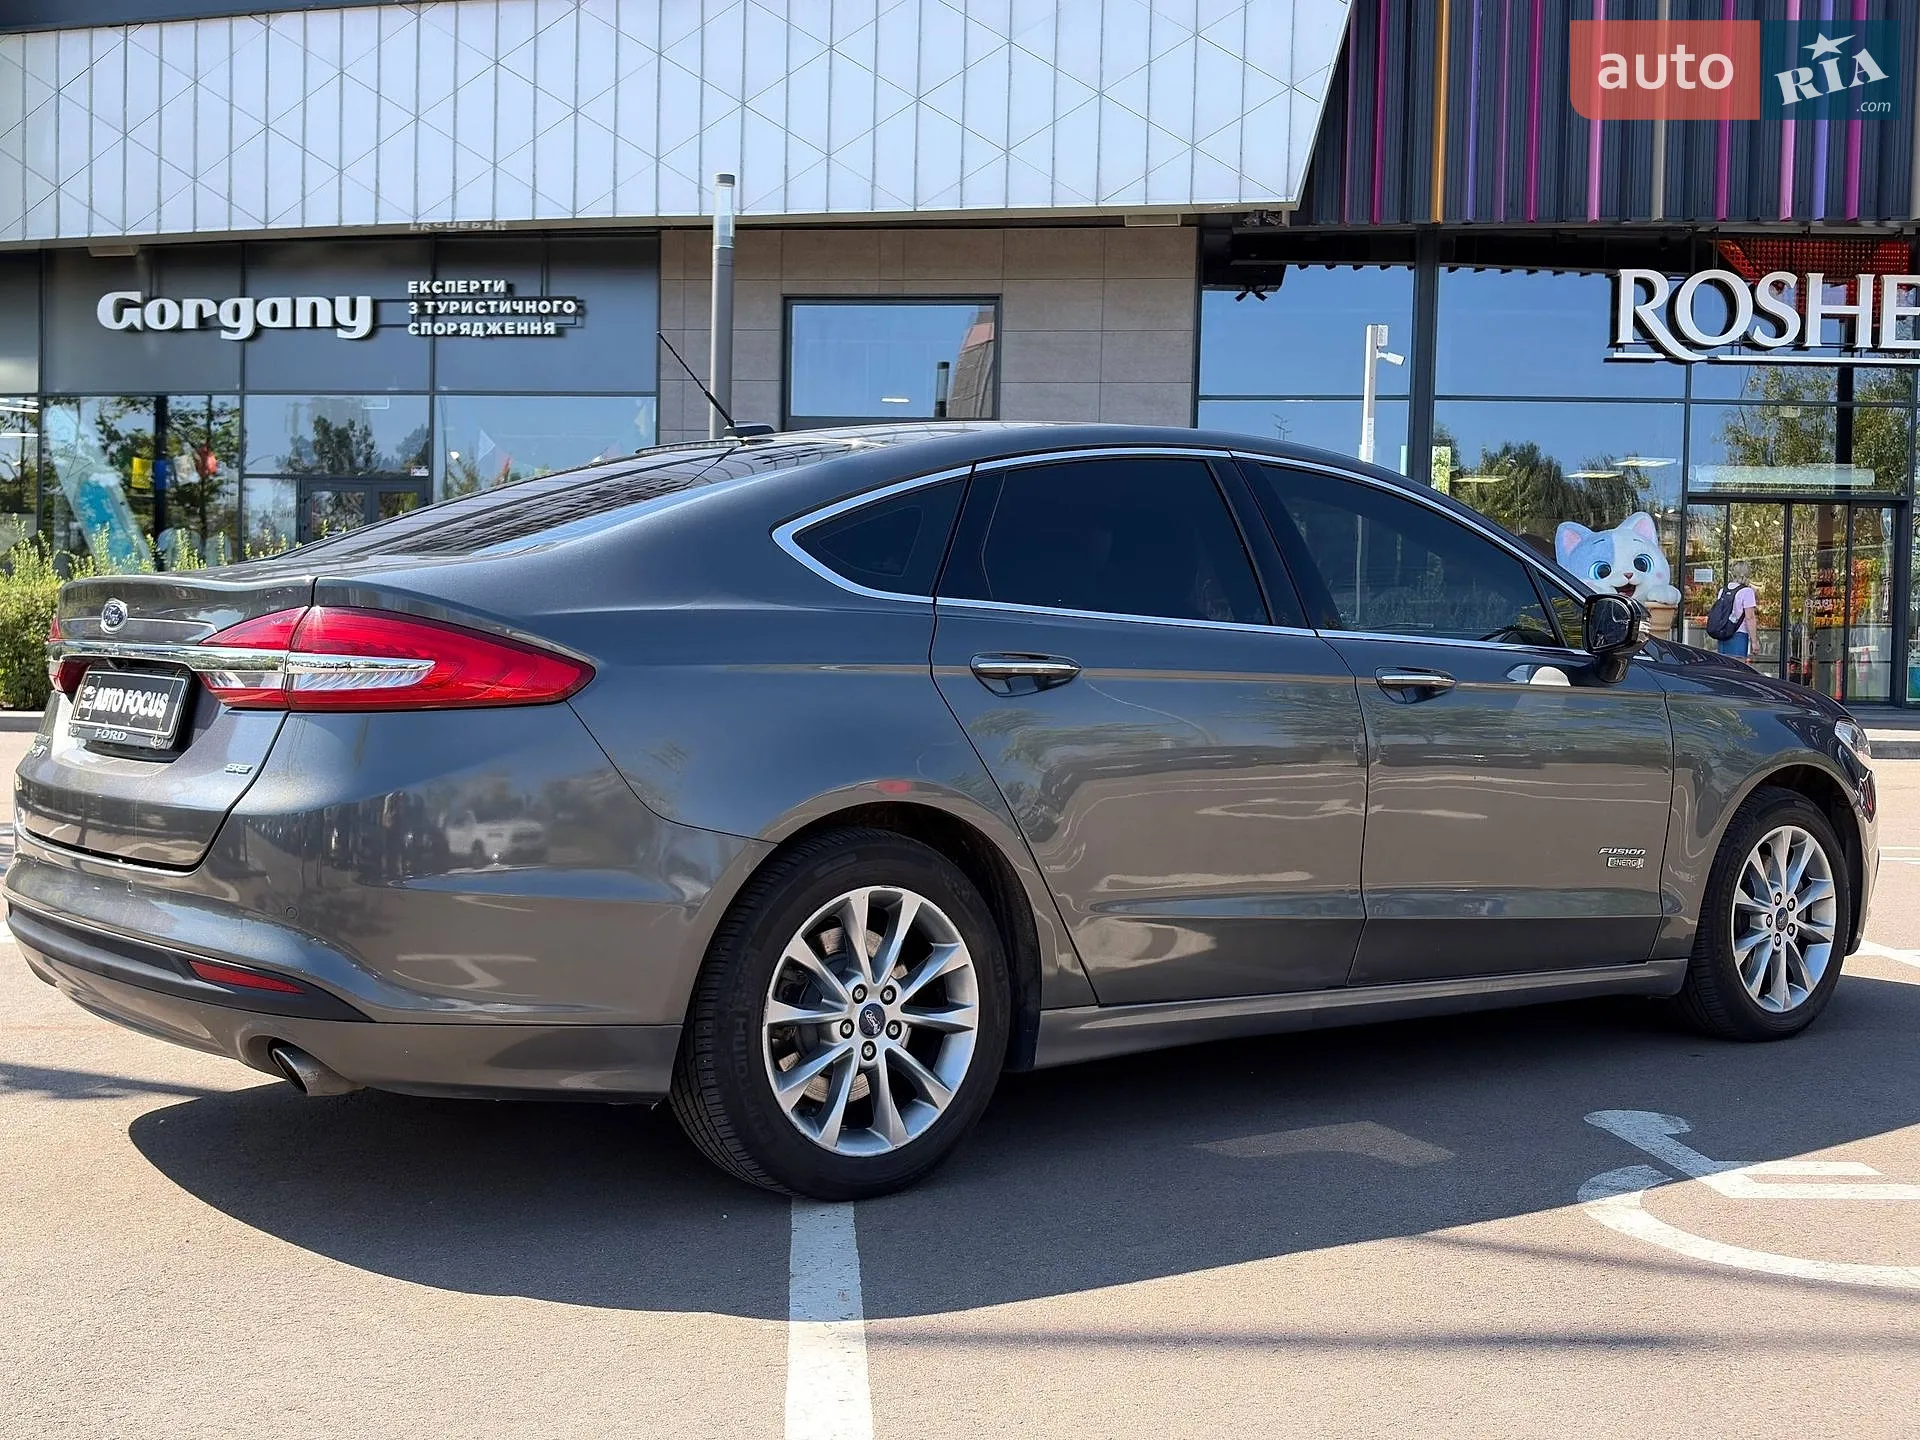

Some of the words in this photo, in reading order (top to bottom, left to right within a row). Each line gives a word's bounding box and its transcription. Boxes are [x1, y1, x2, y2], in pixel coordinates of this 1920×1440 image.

[407, 280, 507, 294] ЕКСПЕРТИ
[424, 300, 577, 315] ТУРИСТИЧНОГО
[96, 291, 374, 341] Gorgany
[407, 322, 556, 337] СПОРЯДЖЕННЯ
[121, 690, 169, 719] FOCUS
[94, 728, 129, 741] FORD
